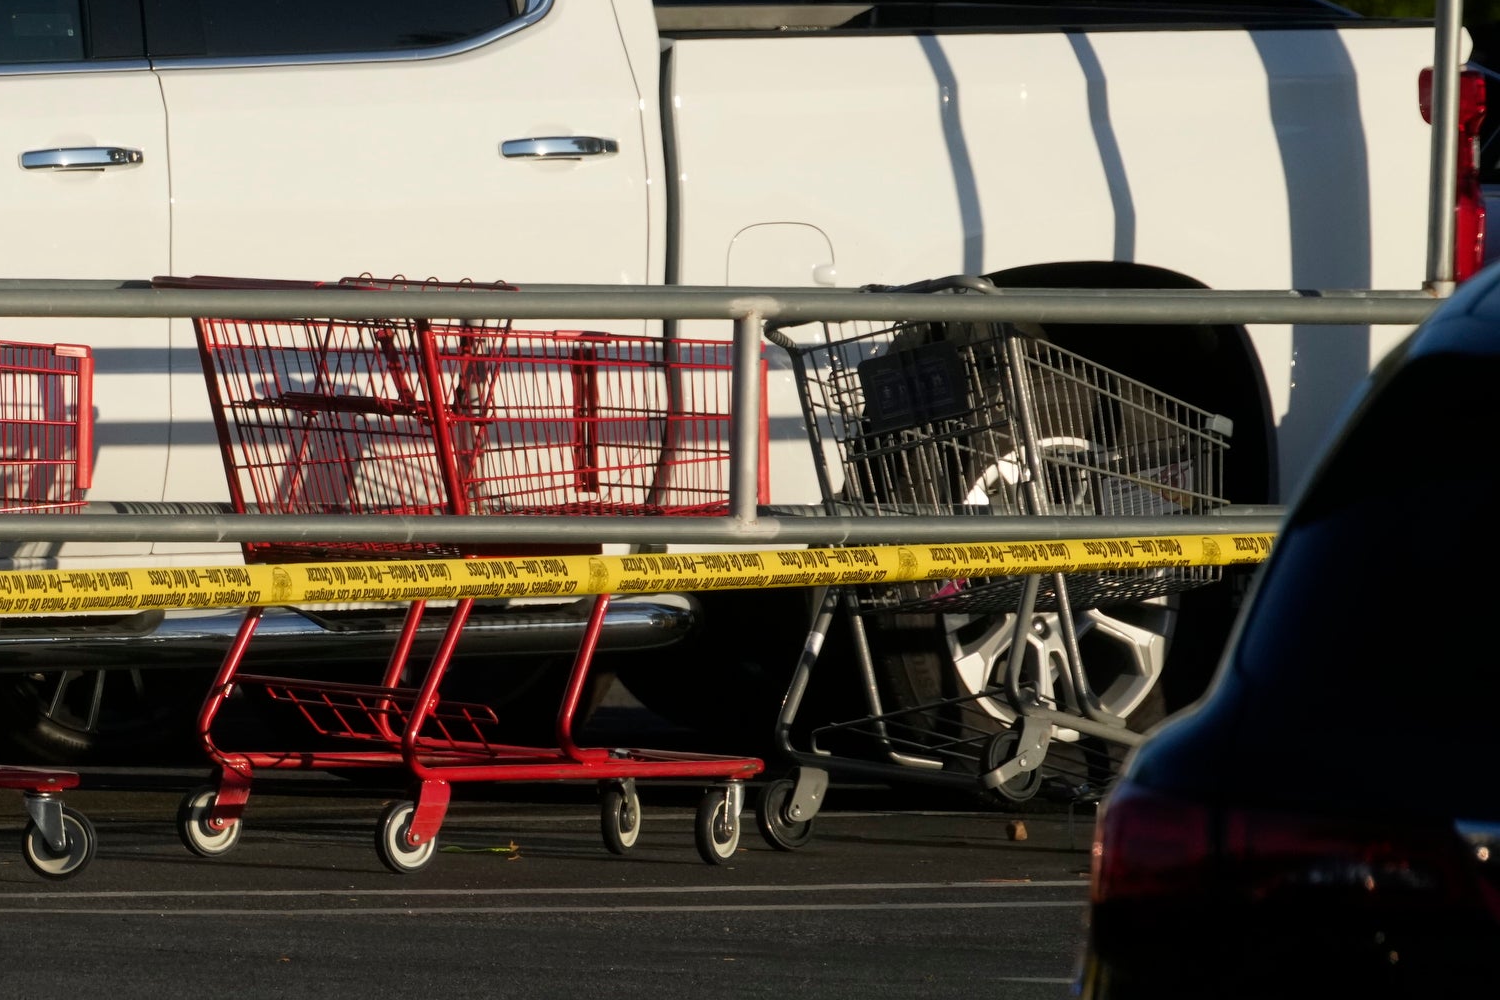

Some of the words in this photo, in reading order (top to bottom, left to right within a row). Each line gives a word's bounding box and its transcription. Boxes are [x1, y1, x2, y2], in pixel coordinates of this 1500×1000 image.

[11, 575, 24, 593] No
[25, 575, 46, 593] Favor
[97, 573, 109, 591] De
[147, 571, 171, 588] Cross
[171, 570, 187, 588] Not
[225, 568, 251, 586] Police
[16, 598, 29, 612] Los
[30, 598, 39, 611] De
[70, 597, 80, 611] De
[80, 595, 137, 608] Departamento
[139, 592, 185, 608] Department
[186, 592, 212, 606] Police
[213, 590, 245, 606] Angeles
[246, 591, 260, 604] Los
